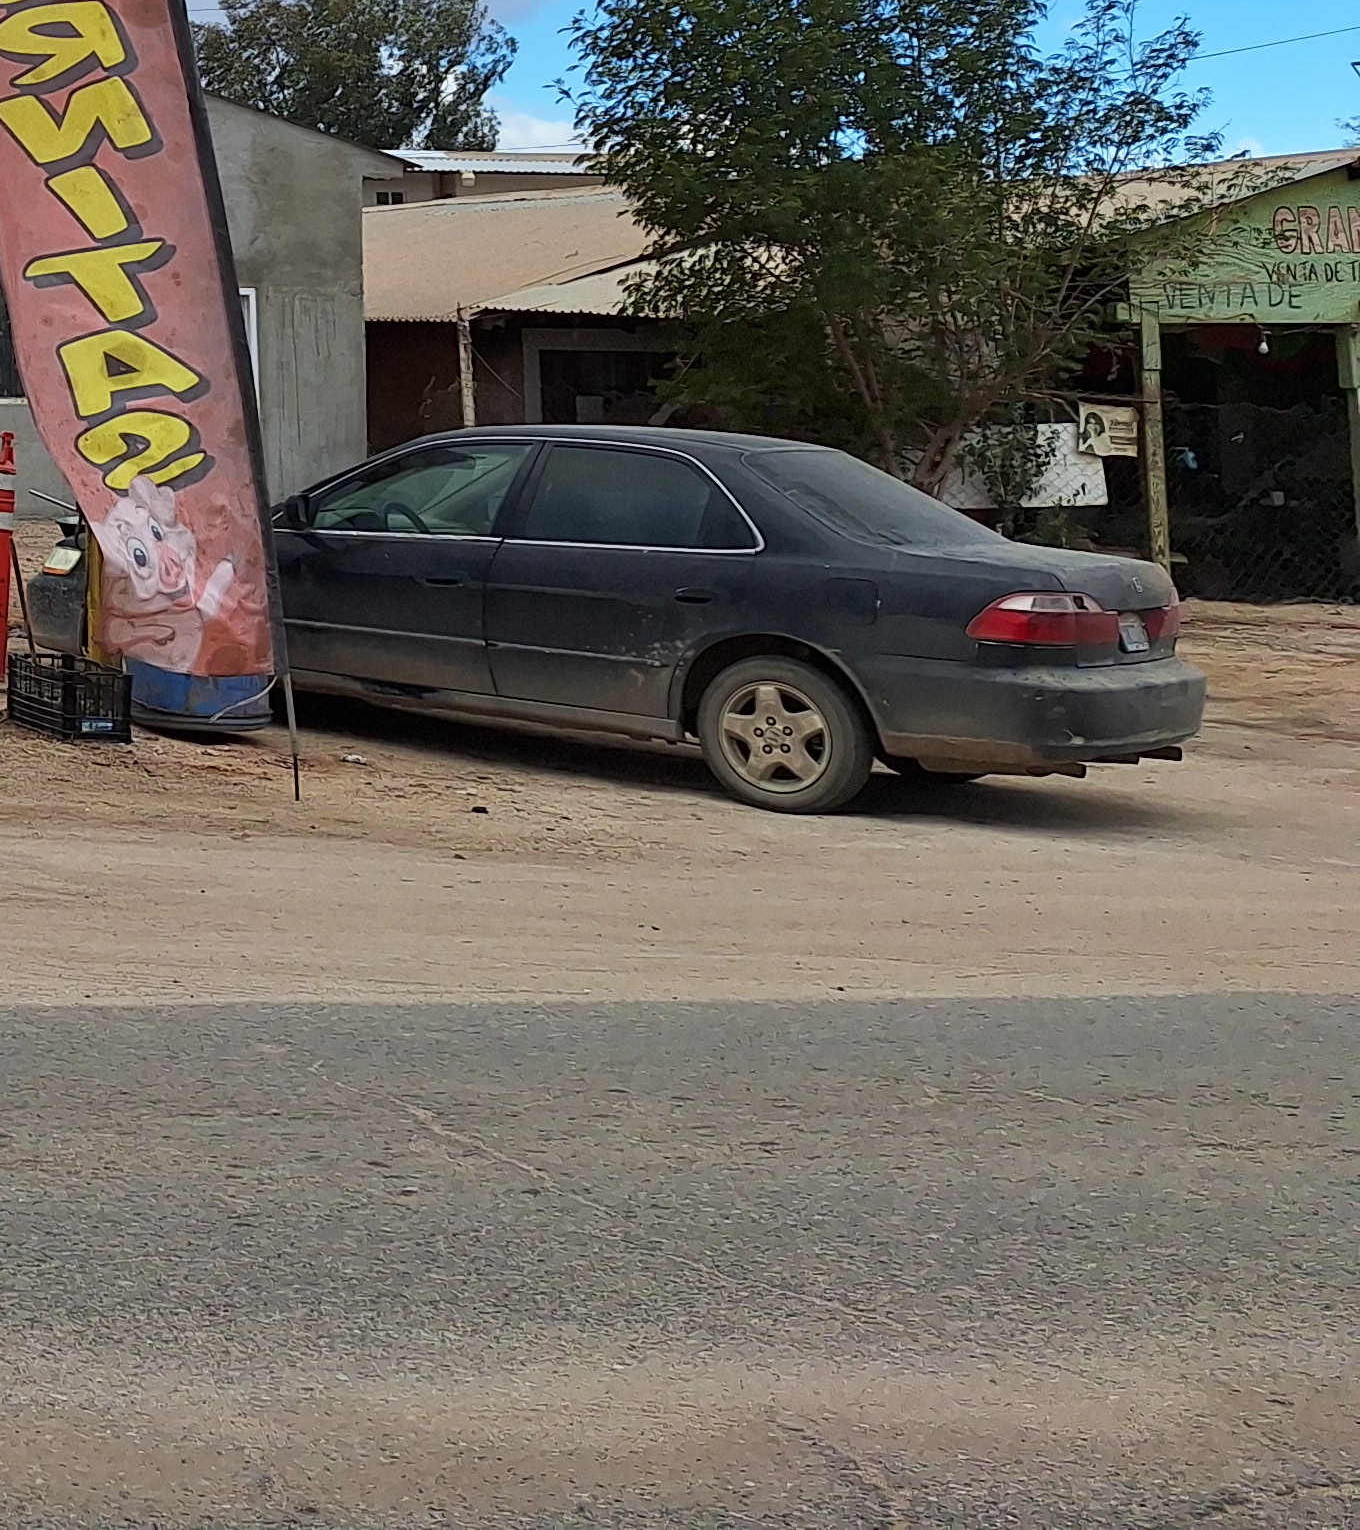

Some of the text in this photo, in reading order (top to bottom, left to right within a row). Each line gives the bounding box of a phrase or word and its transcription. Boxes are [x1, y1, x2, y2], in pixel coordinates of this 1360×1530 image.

[1325, 262, 1345, 282] DE
[1162, 282, 1303, 310] VENTA DE
